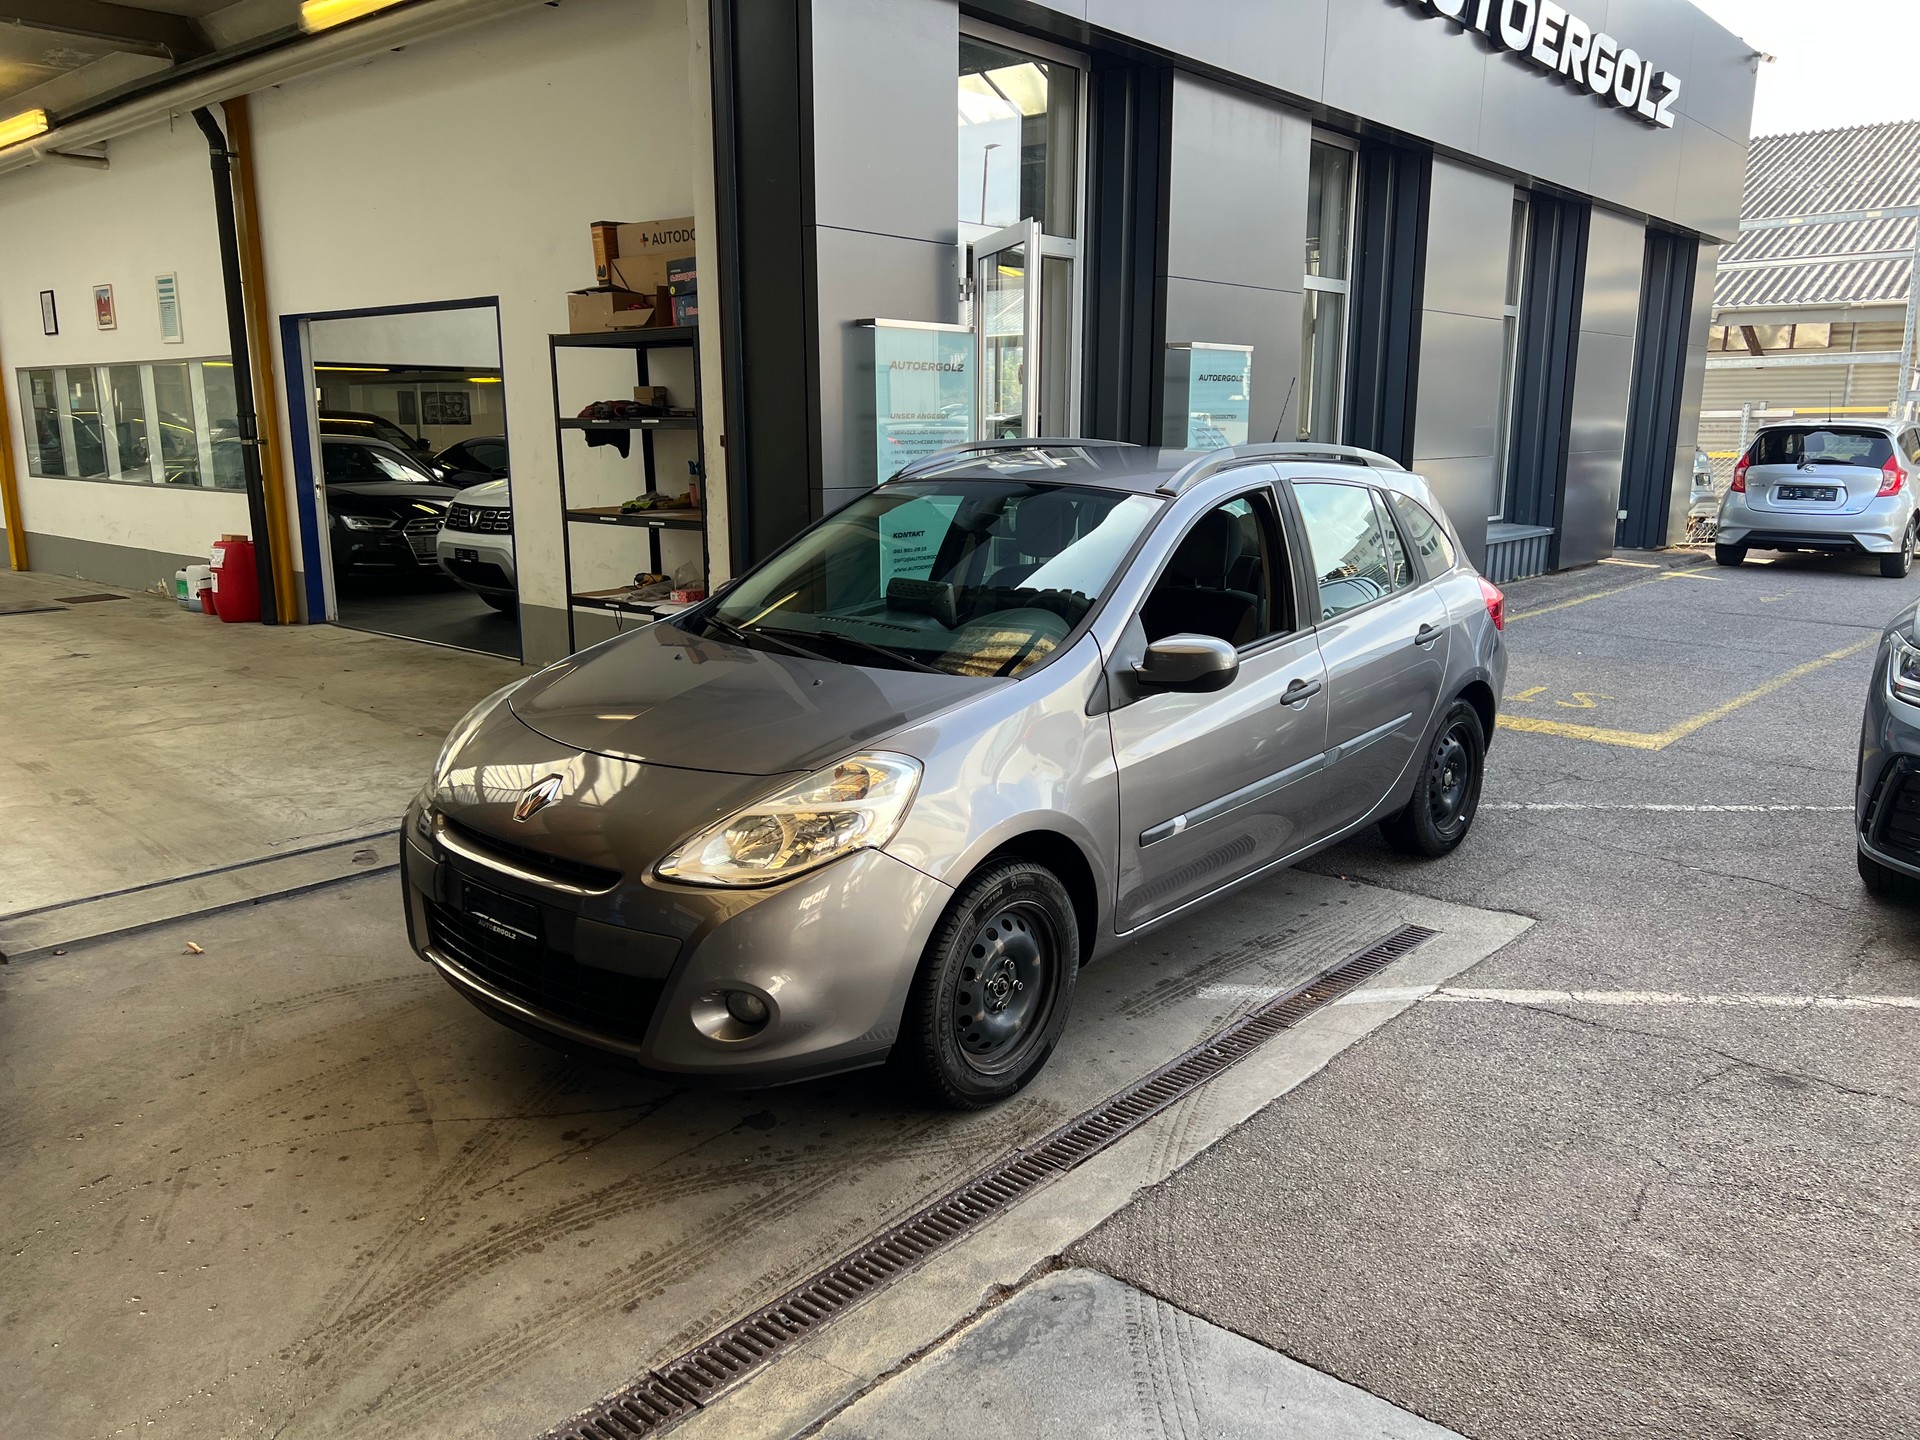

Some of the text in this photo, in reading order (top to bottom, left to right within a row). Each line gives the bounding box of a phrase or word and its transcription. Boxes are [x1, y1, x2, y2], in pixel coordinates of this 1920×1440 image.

[1415, 0, 1681, 129] OERGOLZ
[889, 360, 964, 372] AUTOERGOLZ
[1198, 374, 1243, 382] AUTOERGOLZ
[893, 530, 925, 539] KONTAKT
[478, 919, 516, 940] AUTOERGOLZ
